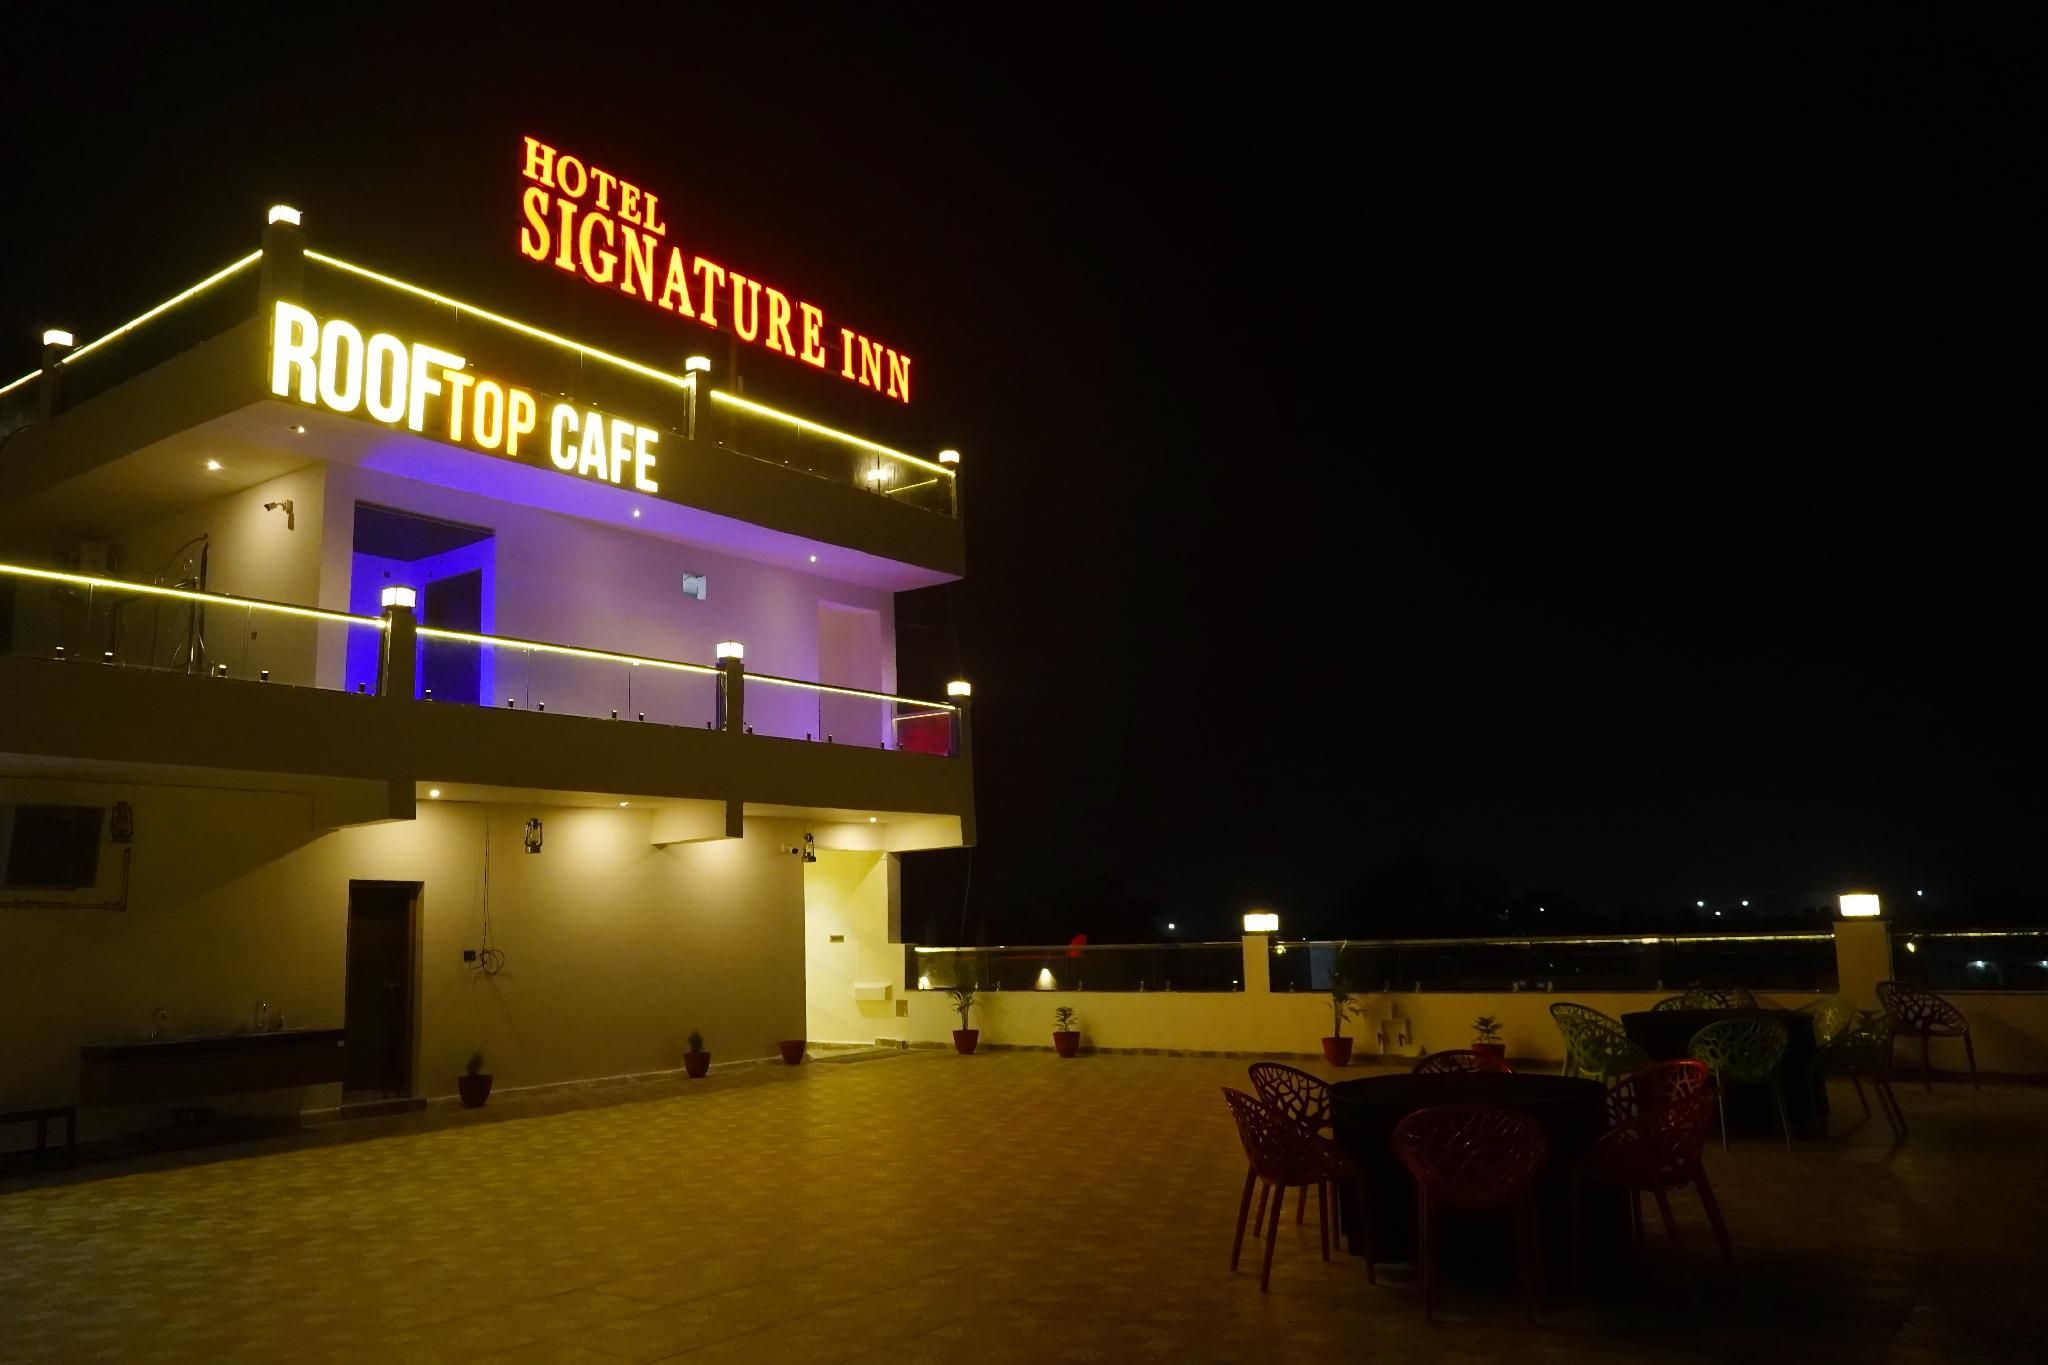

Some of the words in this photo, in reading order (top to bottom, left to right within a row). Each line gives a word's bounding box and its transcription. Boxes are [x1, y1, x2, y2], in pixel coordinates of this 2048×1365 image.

[522, 136, 666, 236] HOTEL
[521, 186, 826, 369] SIGNATURE
[841, 327, 912, 403] INN
[271, 300, 537, 457] ROOFTOP
[549, 403, 660, 493] CAFE
